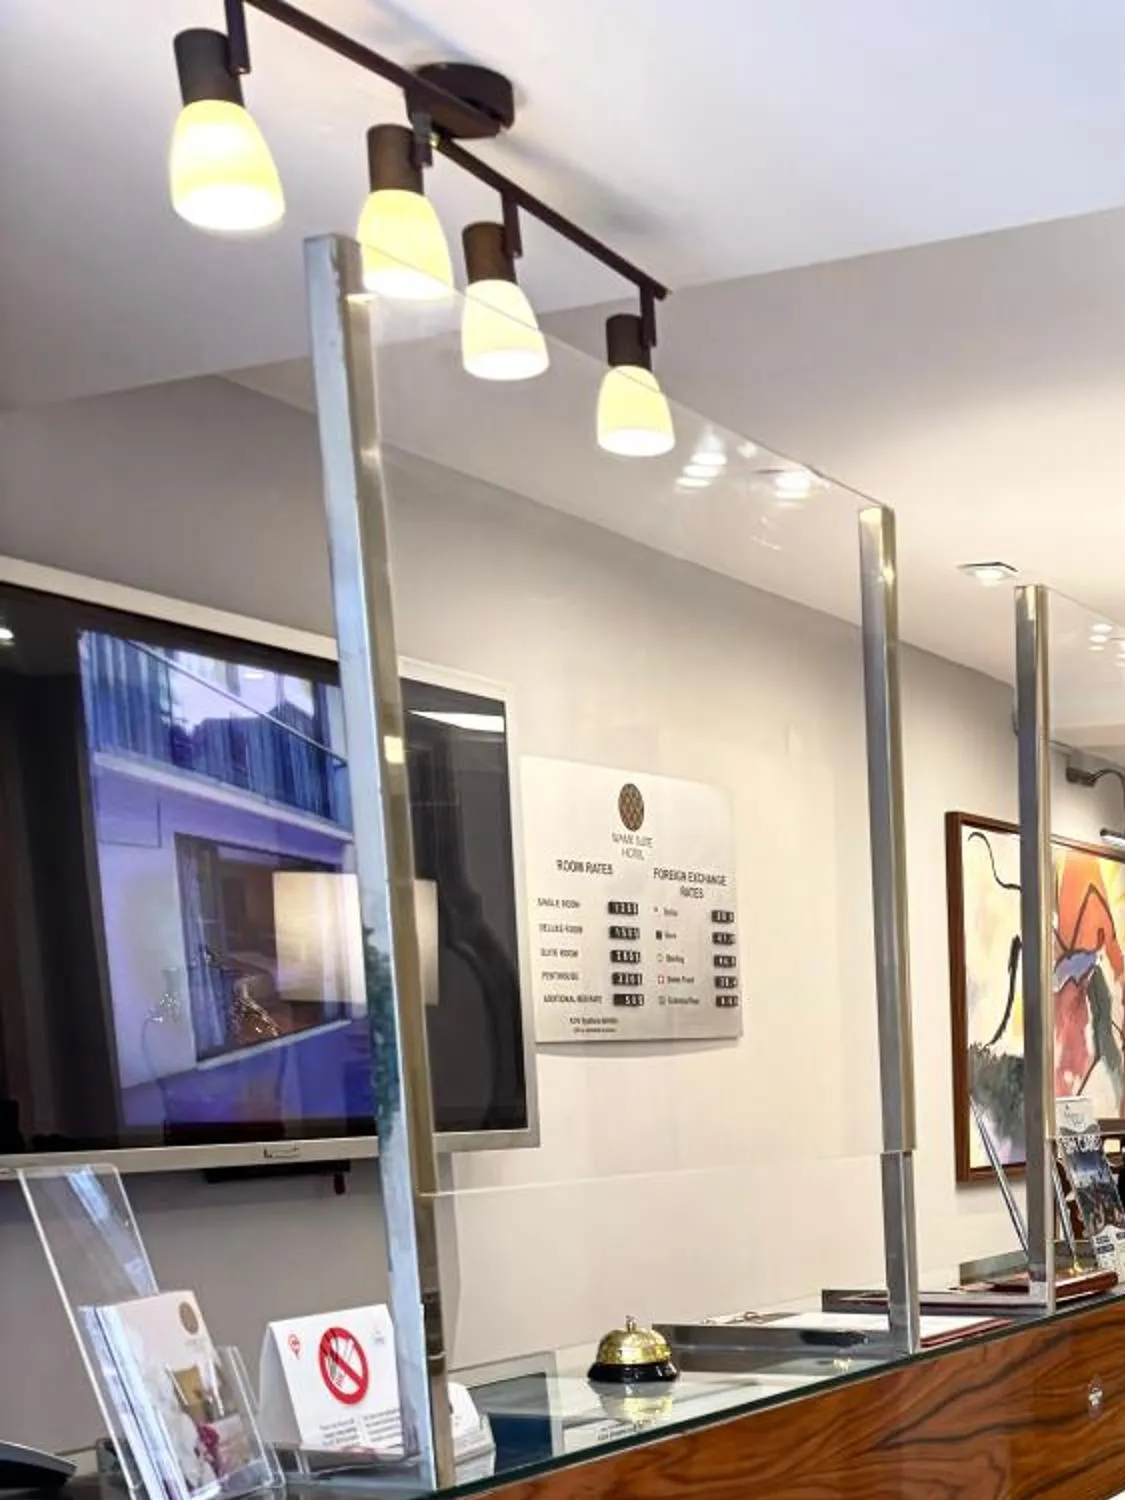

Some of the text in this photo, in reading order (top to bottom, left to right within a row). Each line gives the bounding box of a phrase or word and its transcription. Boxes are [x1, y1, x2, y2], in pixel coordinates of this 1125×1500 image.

[556, 859, 613, 875] ROOM RATES
[653, 867, 687, 881] FOREIGN
